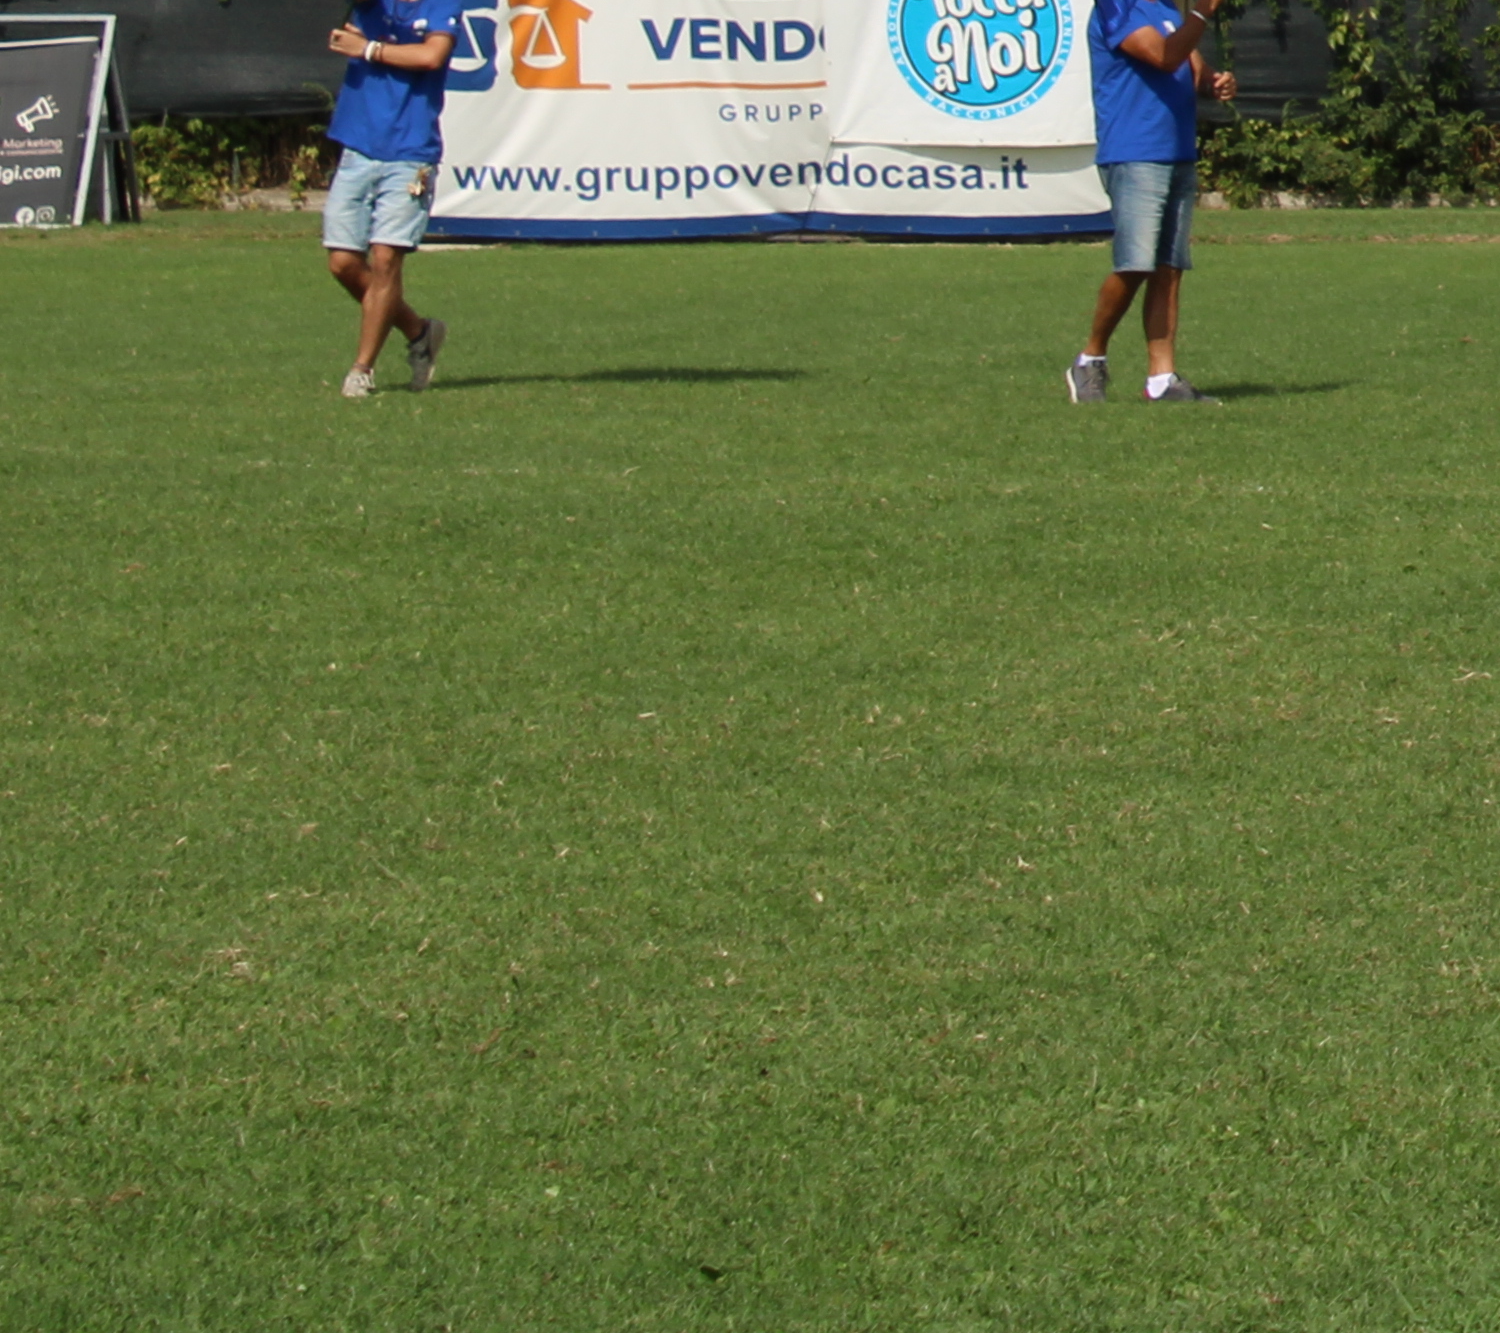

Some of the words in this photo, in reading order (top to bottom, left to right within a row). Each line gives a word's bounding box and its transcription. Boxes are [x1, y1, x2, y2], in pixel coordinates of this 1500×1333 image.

[640, 17, 827, 62] VEND
[933, 62, 959, 94] a
[924, 90, 1041, 121] RACCONIGI
[451, 152, 1029, 201] www.gruppovendocasa.it
